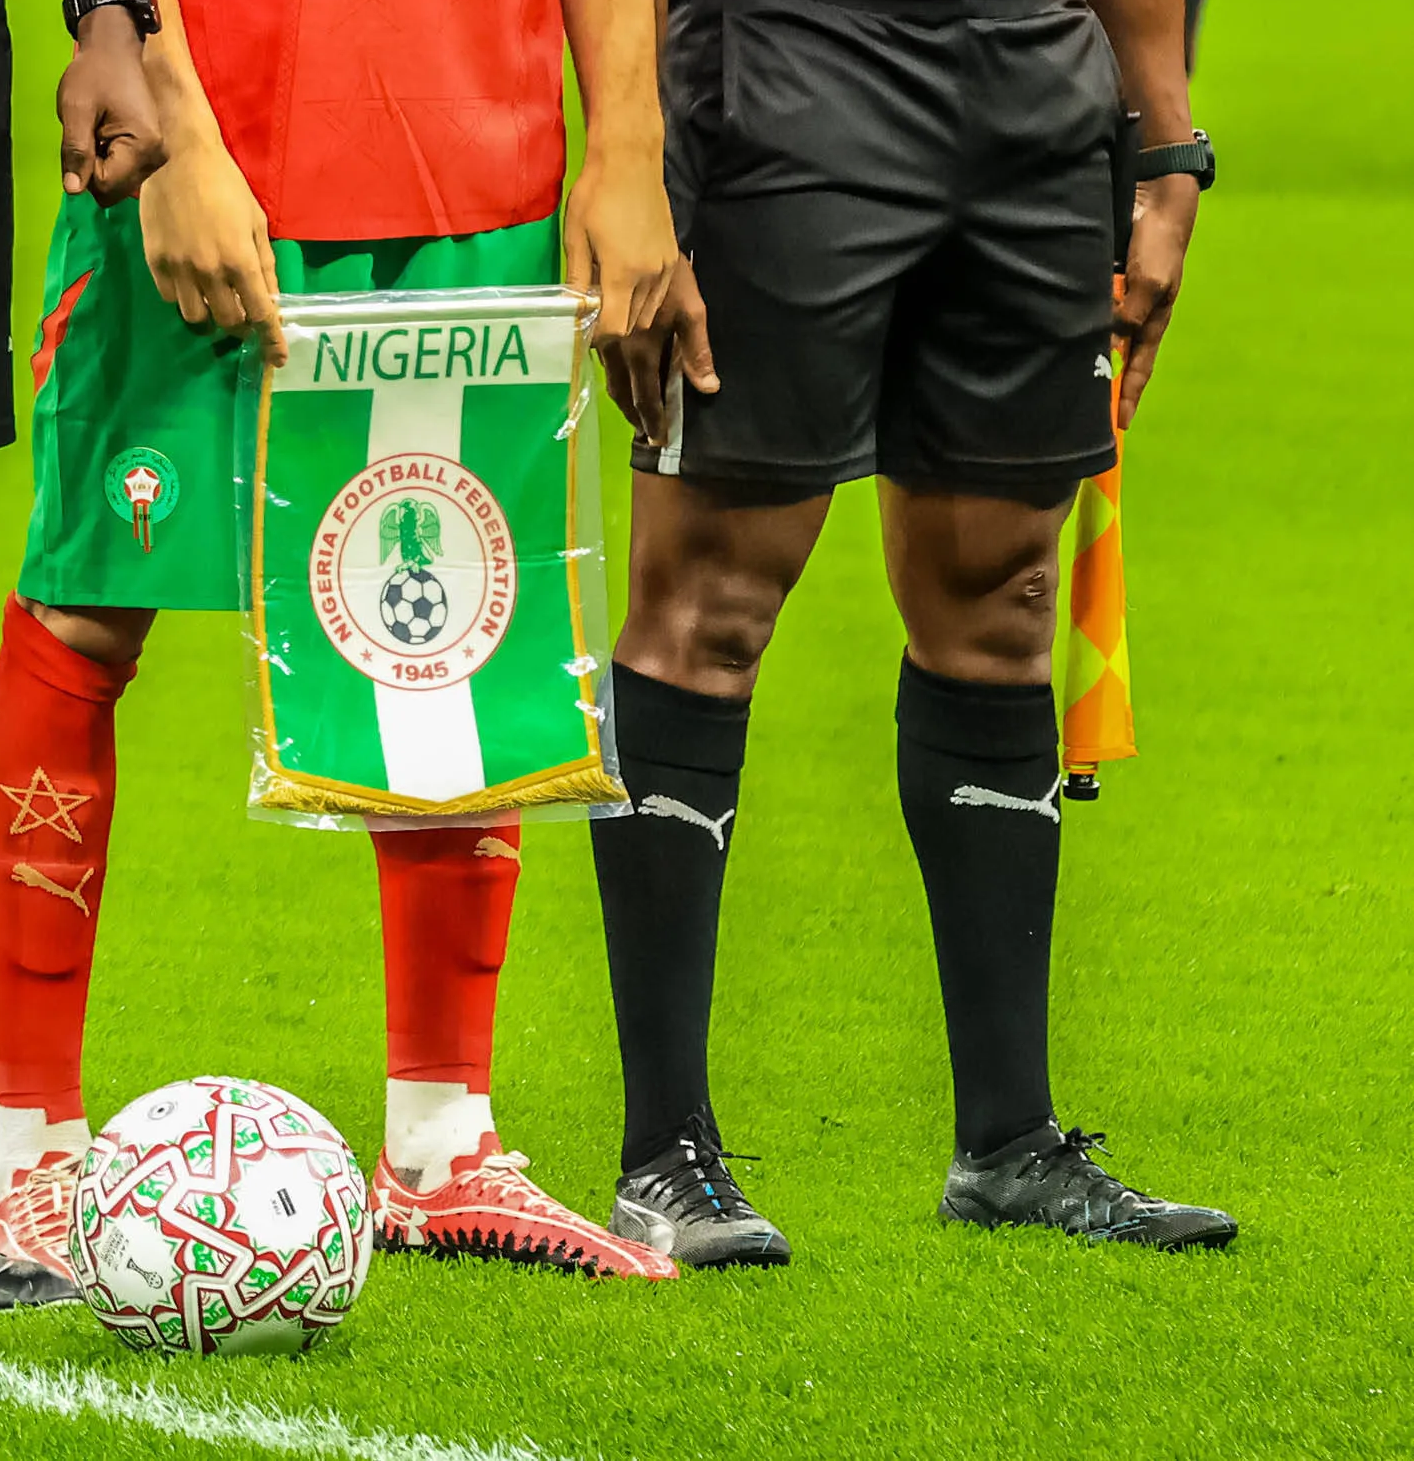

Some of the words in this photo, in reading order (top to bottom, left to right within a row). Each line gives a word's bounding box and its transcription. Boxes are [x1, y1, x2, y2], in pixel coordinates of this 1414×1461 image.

[313, 324, 529, 383] NIGERIA
[332, 462, 448, 524] FOOTBALL
[316, 531, 353, 644] NIGERIA
[453, 476, 509, 639] FEDERATION
[391, 660, 450, 682] 1945
